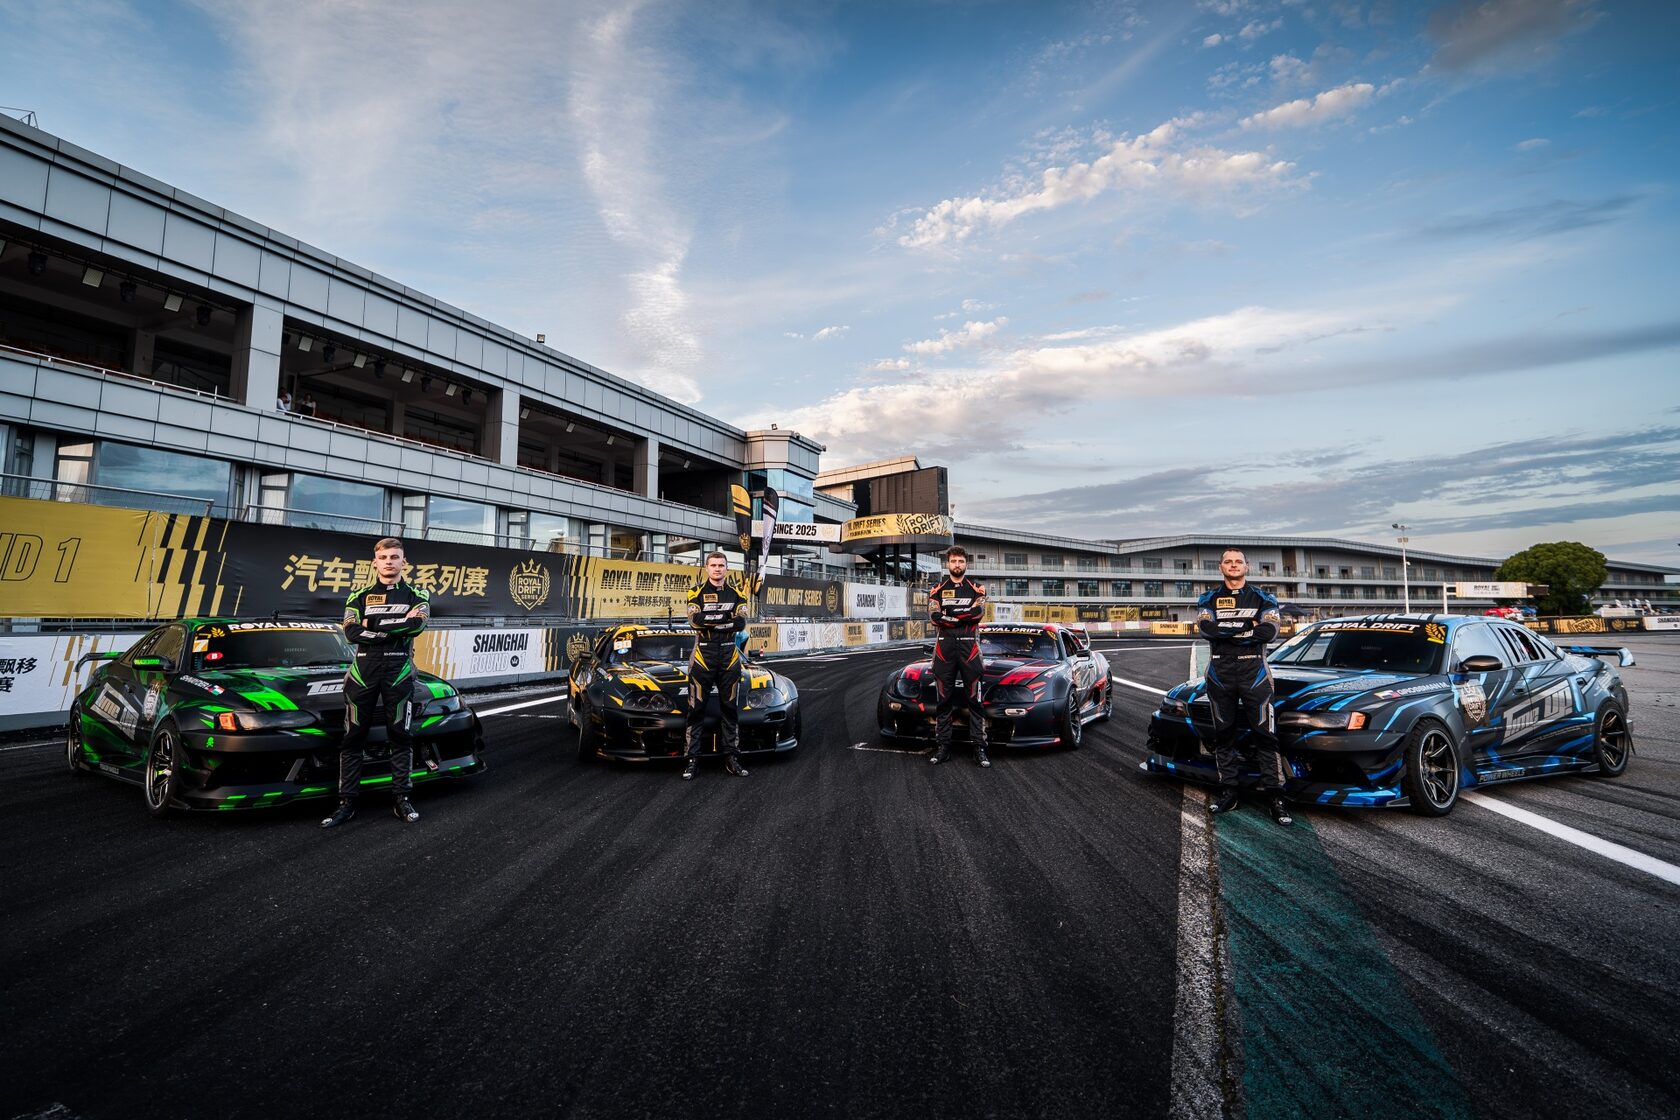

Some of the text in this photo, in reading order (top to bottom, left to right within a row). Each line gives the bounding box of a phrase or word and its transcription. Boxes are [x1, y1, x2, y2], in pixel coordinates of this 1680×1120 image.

[909, 514, 938, 527] ROYA
[912, 517, 941, 534] DRIFT
[773, 524, 817, 537] SINCE 2025
[54, 537, 81, 583] 1
[280, 554, 489, 597] 汽车飘系列赛
[518, 577, 542, 586] ROYAL
[601, 569, 692, 592] ROYAL DRIFT SERIES
[518, 585, 542, 594] DRIFT
[766, 587, 786, 605] ROYAL
[787, 588, 803, 606] DRIFT
[804, 590, 823, 606] SERIES
[228, 622, 335, 631] ROYAL DRIFT
[1320, 622, 1420, 631] ROYAL DRIFT
[473, 633, 529, 653] SHANGHAI
[470, 652, 527, 674] ROUND 1
